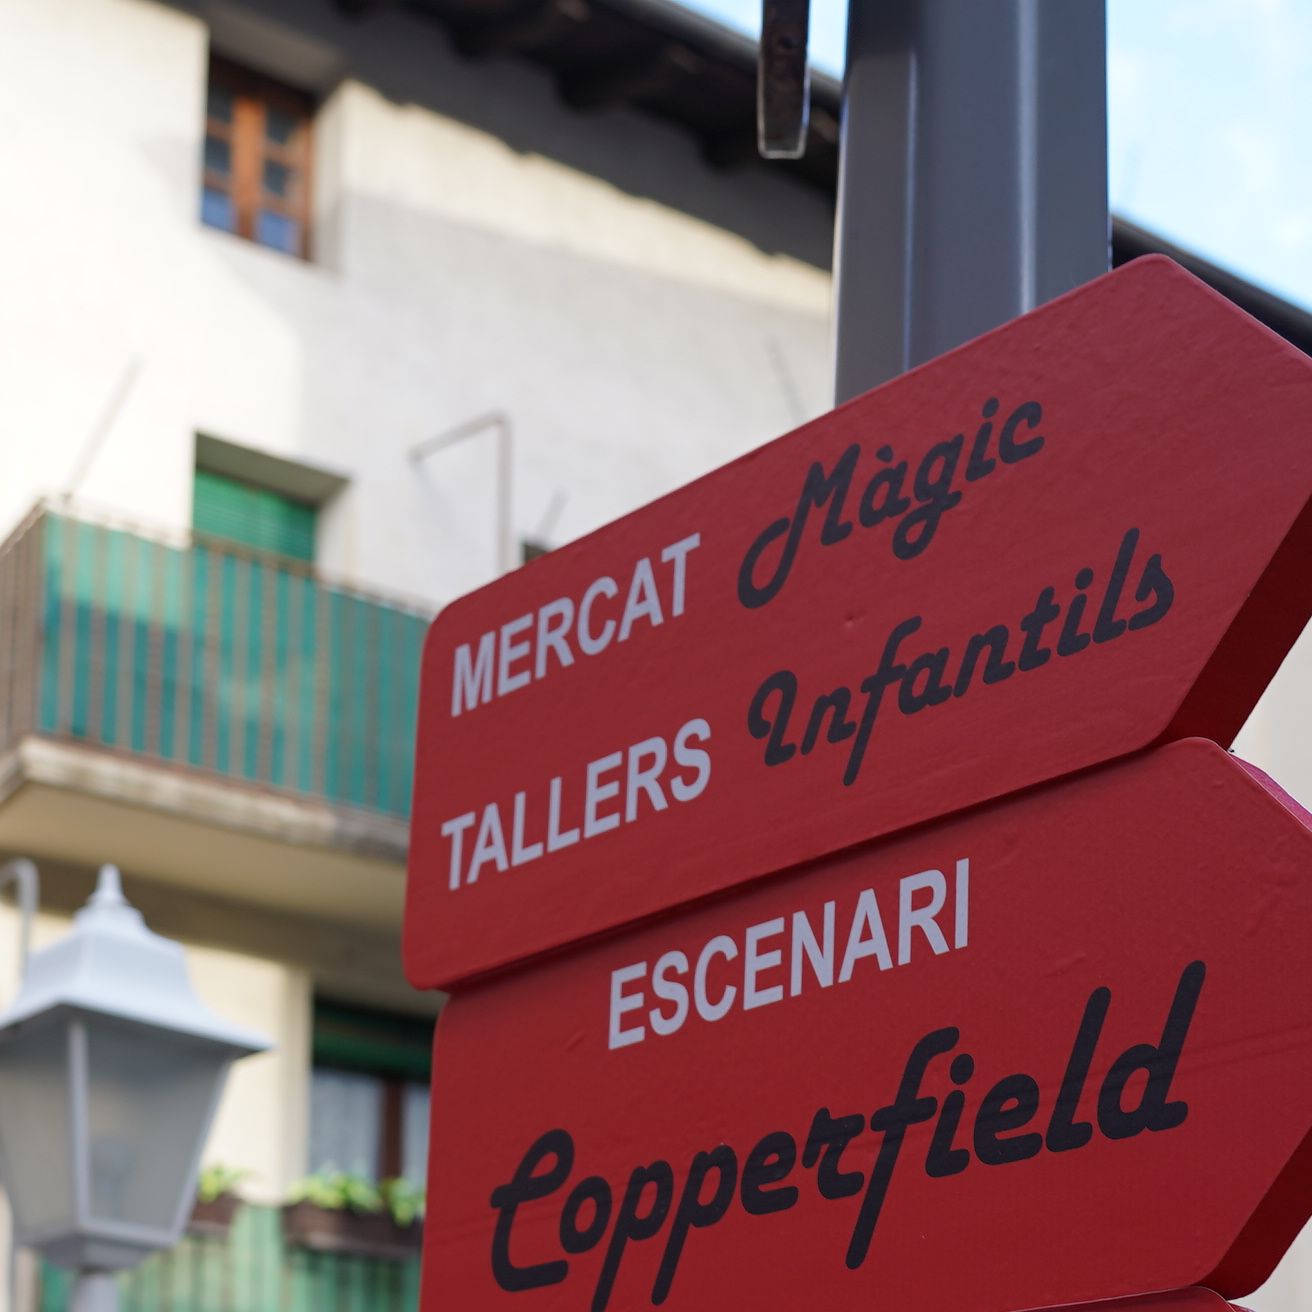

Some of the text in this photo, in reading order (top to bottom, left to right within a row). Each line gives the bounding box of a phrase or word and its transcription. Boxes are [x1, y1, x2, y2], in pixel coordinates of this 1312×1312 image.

[440, 527, 1175, 891] TALLERS Infantils
[451, 396, 1046, 718] MERCAT Màgic
[608, 858, 972, 1050] ESCENARI
